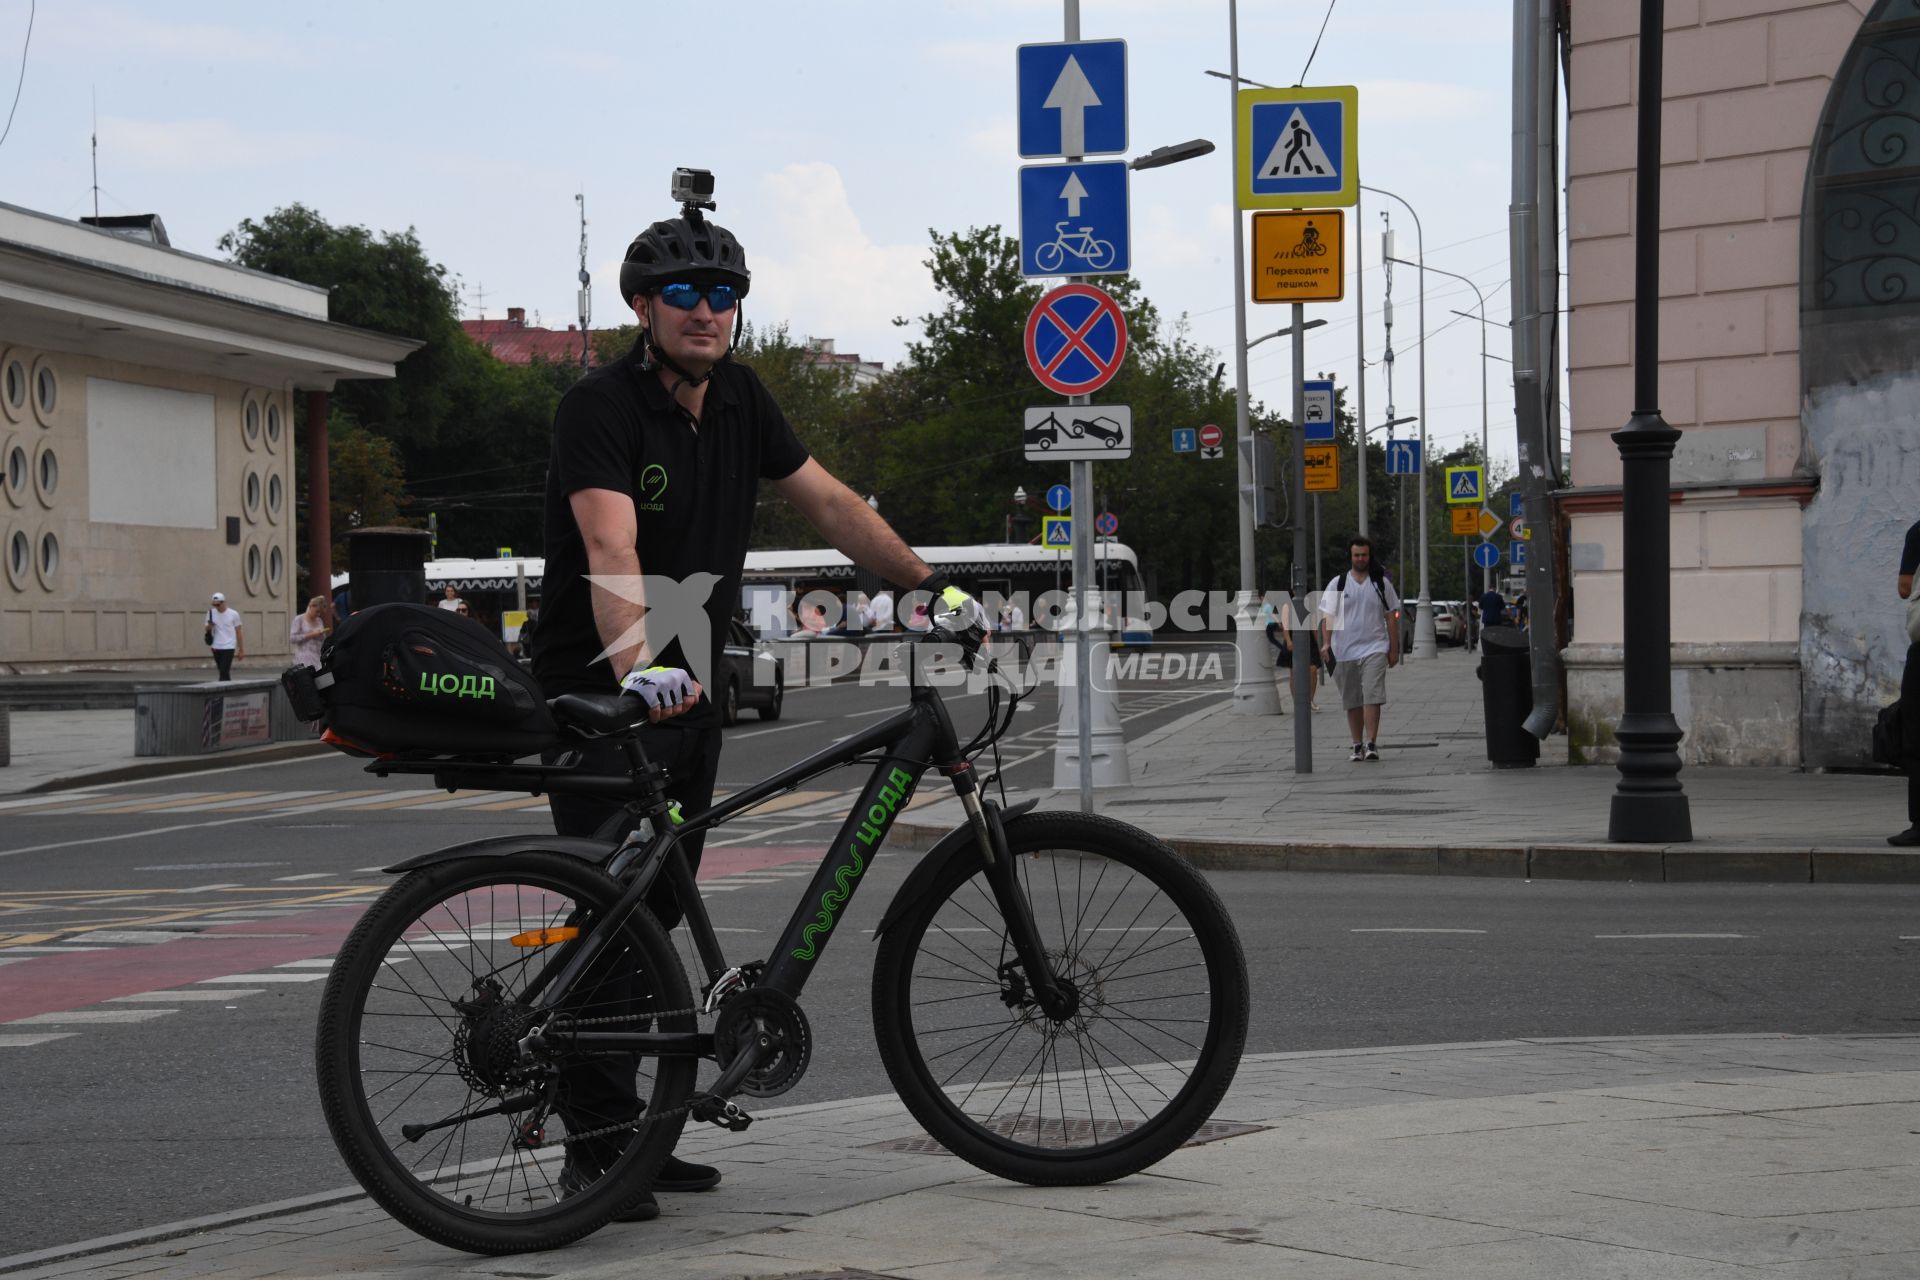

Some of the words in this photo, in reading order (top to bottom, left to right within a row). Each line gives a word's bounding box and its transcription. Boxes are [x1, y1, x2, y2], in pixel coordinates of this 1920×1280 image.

[1266, 266, 1329, 276] Переходите
[1277, 280, 1318, 288] пешком
[640, 503, 665, 511] ЦОДД
[420, 672, 495, 700] ЦОДД
[855, 767, 912, 846] ЦОДД
